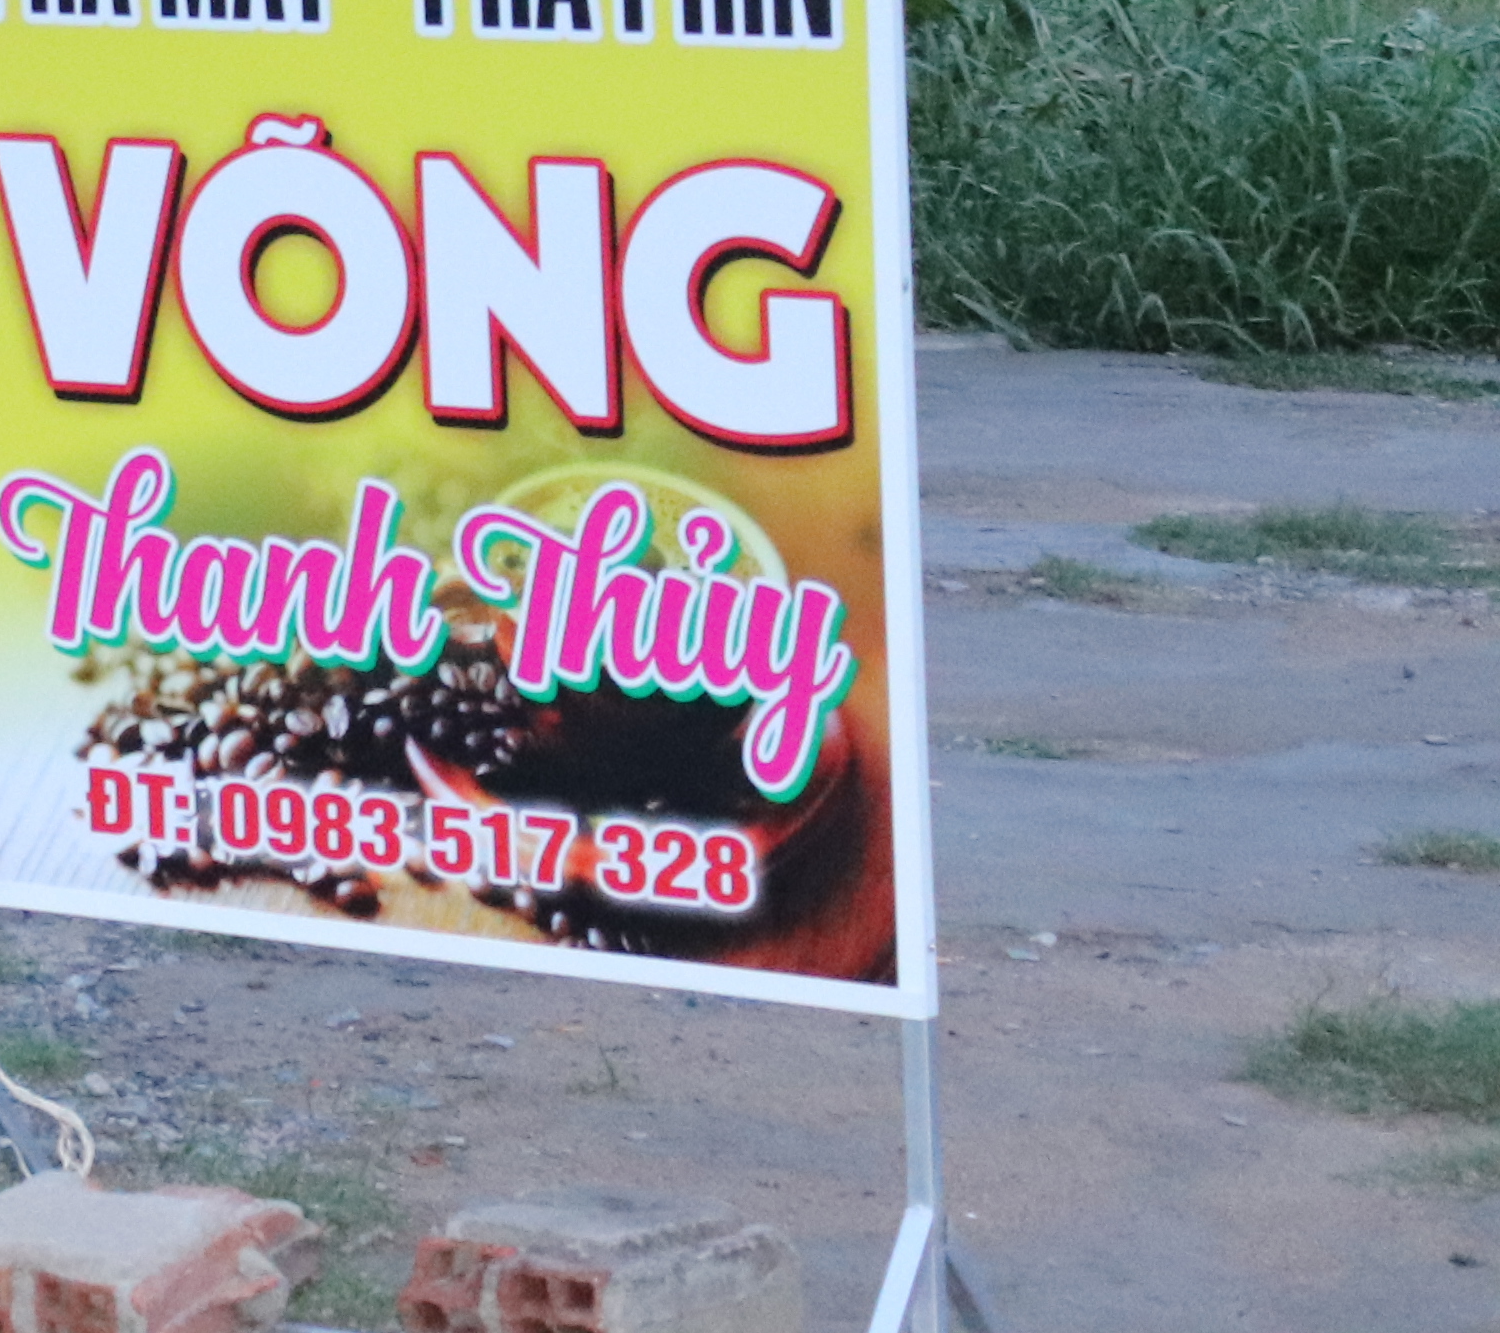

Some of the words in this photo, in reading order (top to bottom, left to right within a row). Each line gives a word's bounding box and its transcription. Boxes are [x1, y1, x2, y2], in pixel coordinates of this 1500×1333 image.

[454, 480, 856, 801] Thủy
[86, 766, 194, 844] ĐT:
[218, 777, 403, 867] 0983
[426, 807, 575, 884] 517
[600, 820, 753, 906] 328
